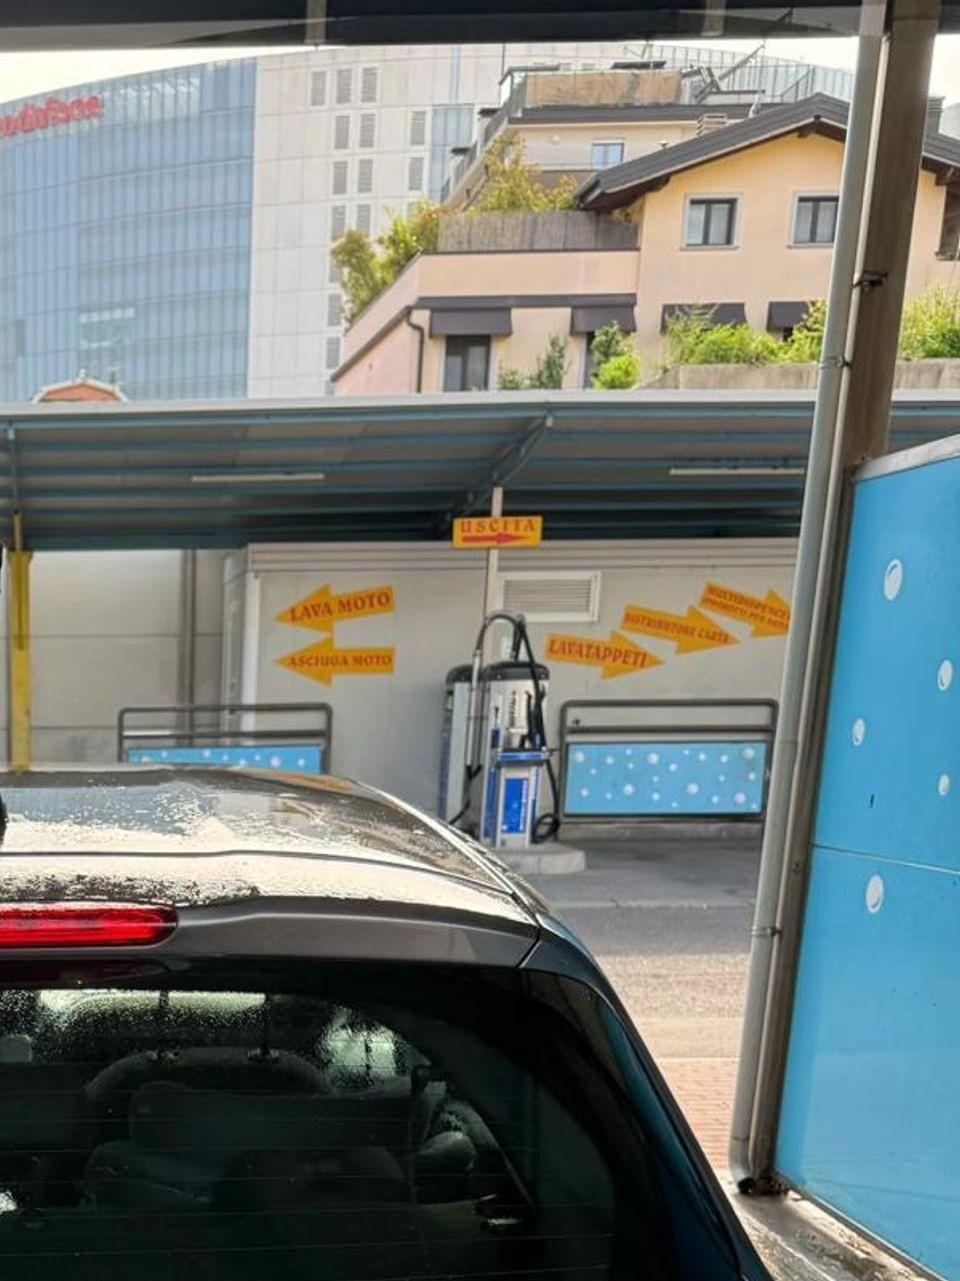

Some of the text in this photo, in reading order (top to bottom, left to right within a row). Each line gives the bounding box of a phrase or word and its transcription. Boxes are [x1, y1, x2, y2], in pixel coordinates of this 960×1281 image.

[460, 518, 535, 533] USCITA
[289, 591, 391, 623] LAVA MOTO
[288, 655, 392, 668] ASCIUGA MOTO
[549, 639, 647, 668] LAVATAPPETI
